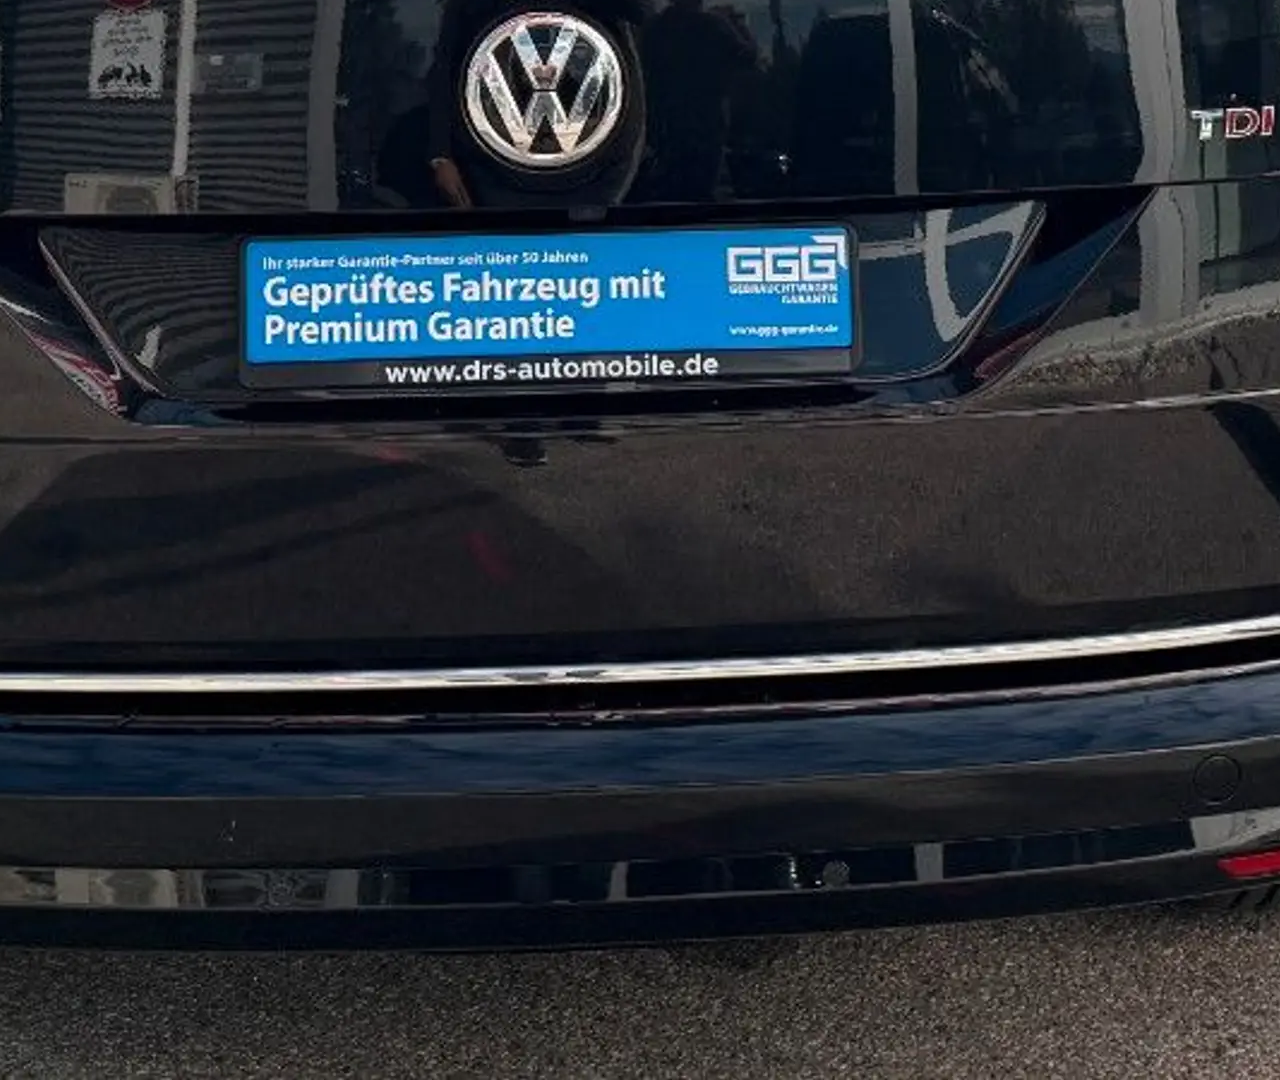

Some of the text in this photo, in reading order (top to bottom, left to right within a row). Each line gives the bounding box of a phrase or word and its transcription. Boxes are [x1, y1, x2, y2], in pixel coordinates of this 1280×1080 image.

[1191, 105, 1275, 140] TDI
[263, 252, 588, 270] Ihr starker Garantie-Partner seit über 50 Jahren
[727, 245, 837, 282] GGG
[263, 269, 666, 313] Geprüftes Fahrzeug mit
[264, 309, 575, 345] Premium Garantie
[385, 353, 719, 383] www.drs-automobile.de
